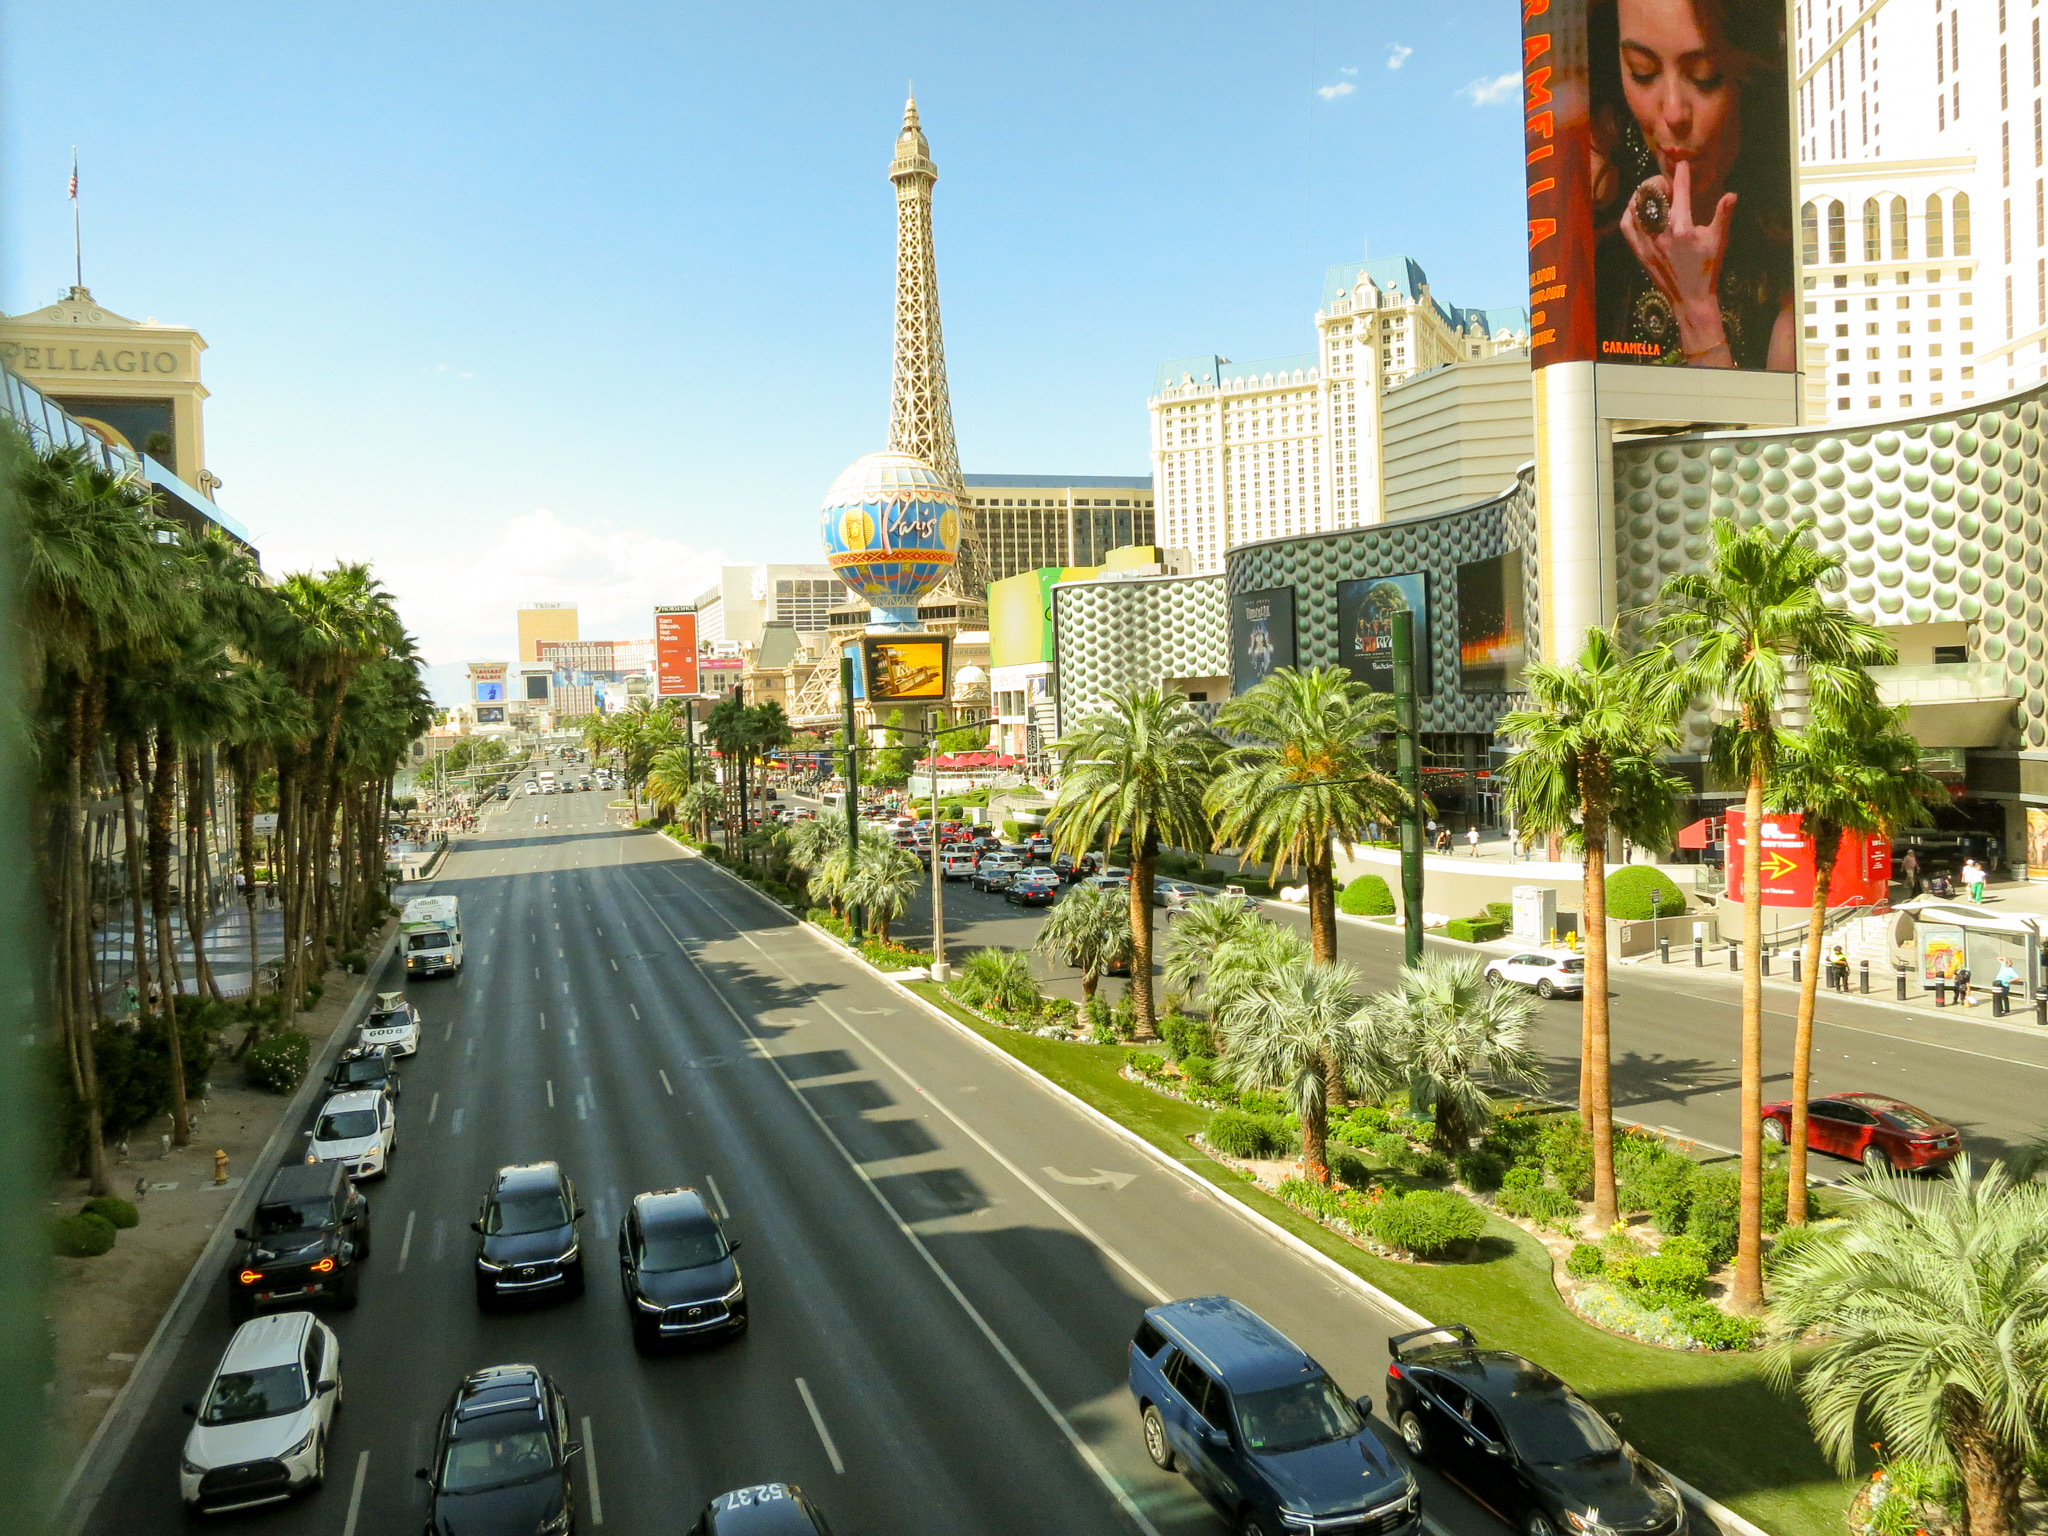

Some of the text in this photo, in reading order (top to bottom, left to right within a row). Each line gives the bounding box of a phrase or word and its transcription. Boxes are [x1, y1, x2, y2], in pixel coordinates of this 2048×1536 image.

[1602, 341, 1660, 356] CARAMELLA
[882, 489, 938, 555] Paris
[370, 1028, 403, 1037] 6008
[727, 1484, 783, 1510] 5237
